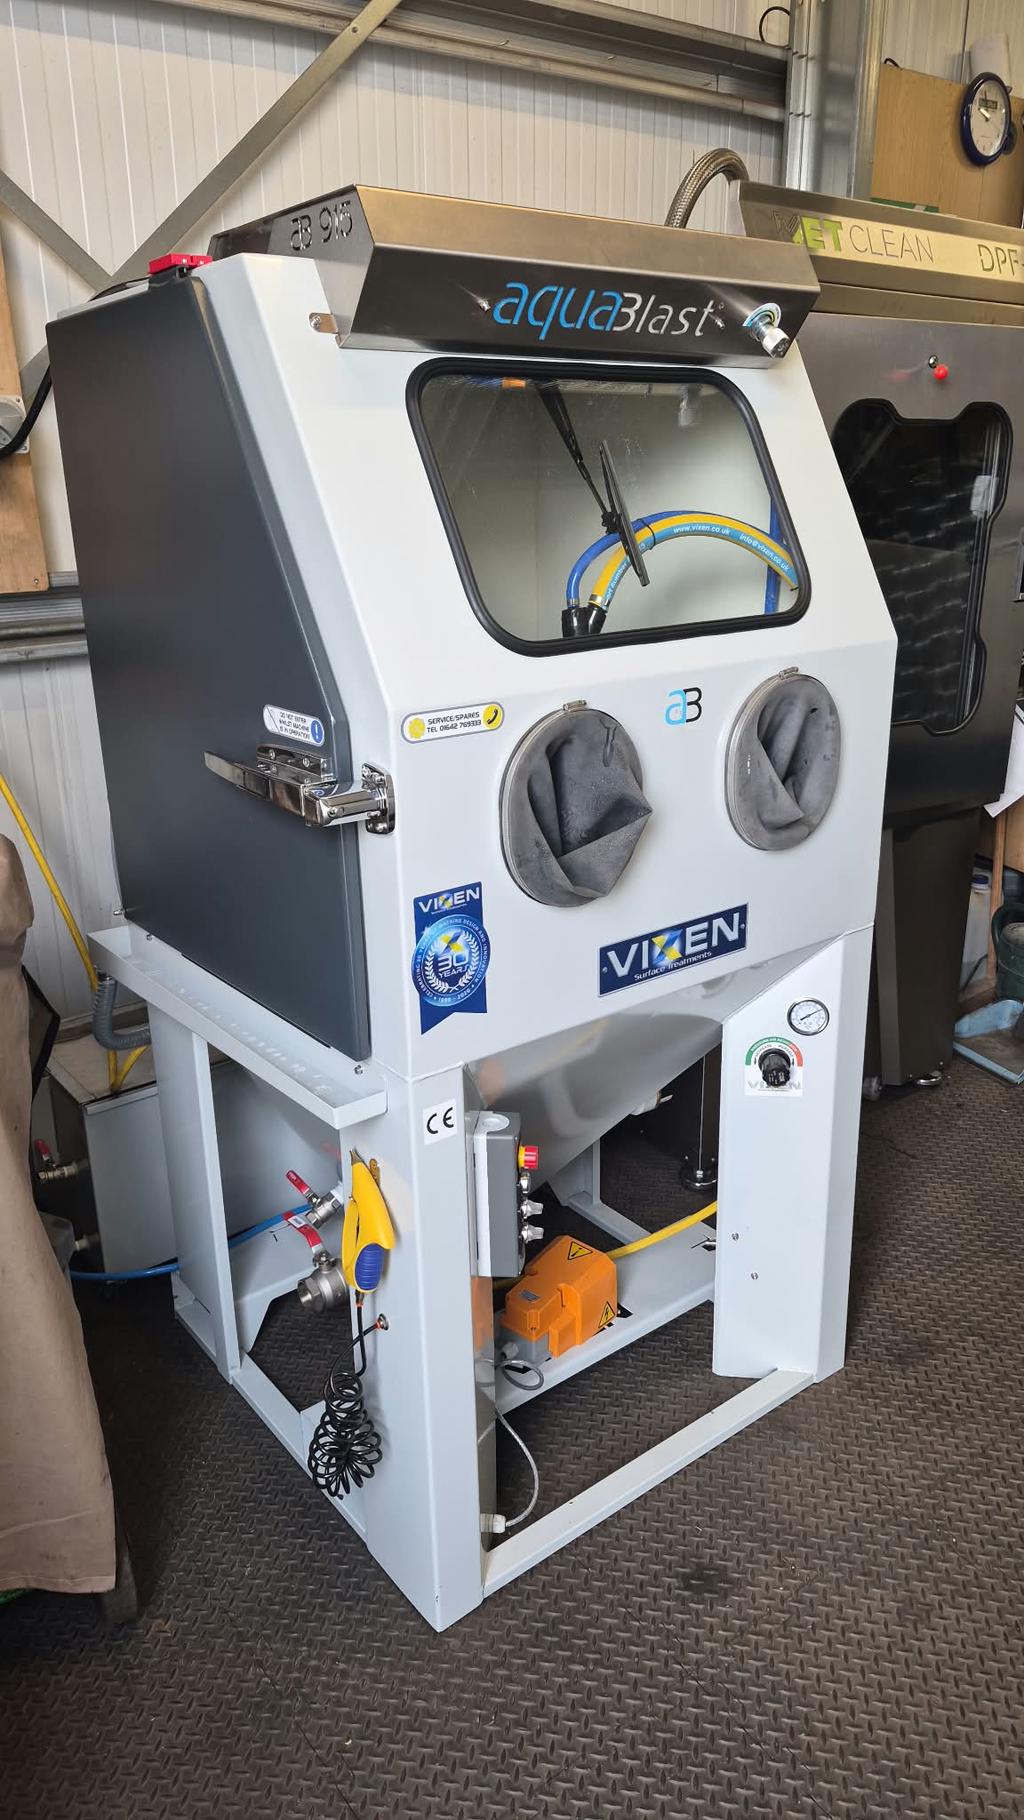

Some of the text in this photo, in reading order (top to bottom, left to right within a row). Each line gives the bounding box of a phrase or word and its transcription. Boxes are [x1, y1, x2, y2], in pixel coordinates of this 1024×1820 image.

[319, 200, 353, 243] 915
[849, 224, 935, 264] CLEAN
[492, 281, 714, 341] aquaBlast
[673, 523, 790, 571] www.vixen.co.uk info@vixen.co.uk
[428, 712, 480, 725] SERVICE/SPARES
[418, 887, 480, 913] VIXEN
[606, 912, 740, 977] VIXEN
[438, 951, 469, 973] 30
[438, 964, 468, 979] YEARS
[633, 950, 713, 981] Surface Treatments
[426, 1107, 455, 1134] CE
